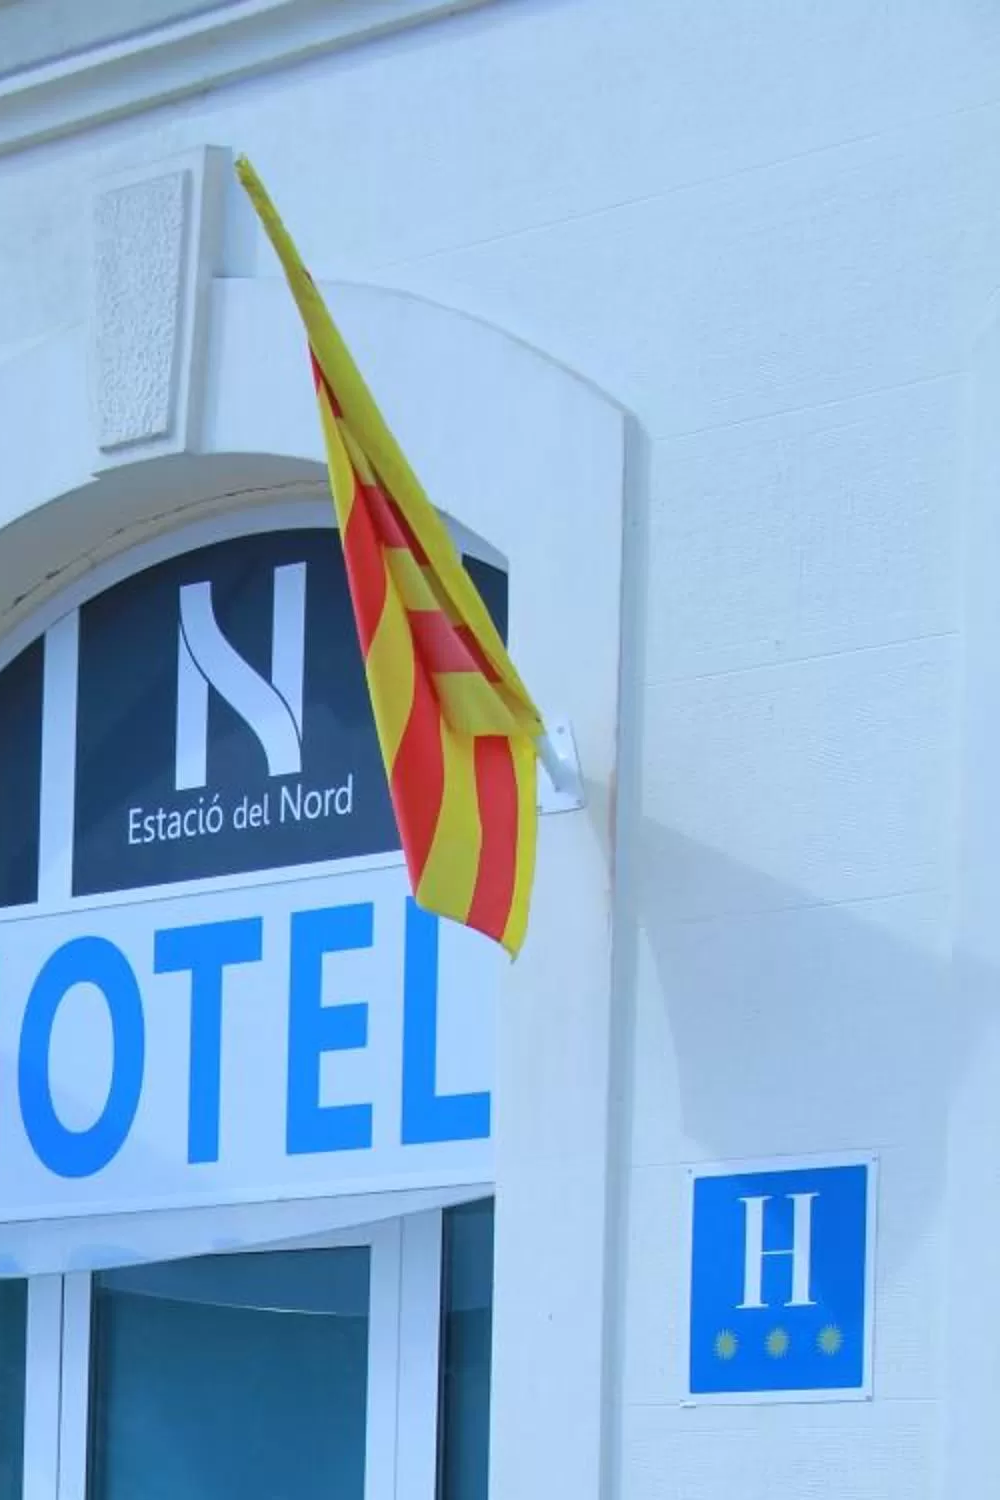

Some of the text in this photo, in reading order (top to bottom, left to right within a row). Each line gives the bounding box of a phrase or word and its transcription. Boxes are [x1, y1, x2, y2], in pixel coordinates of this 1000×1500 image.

[175, 561, 307, 791] N
[127, 773, 354, 845] Estació del Nord
[735, 1192, 821, 1309] H
